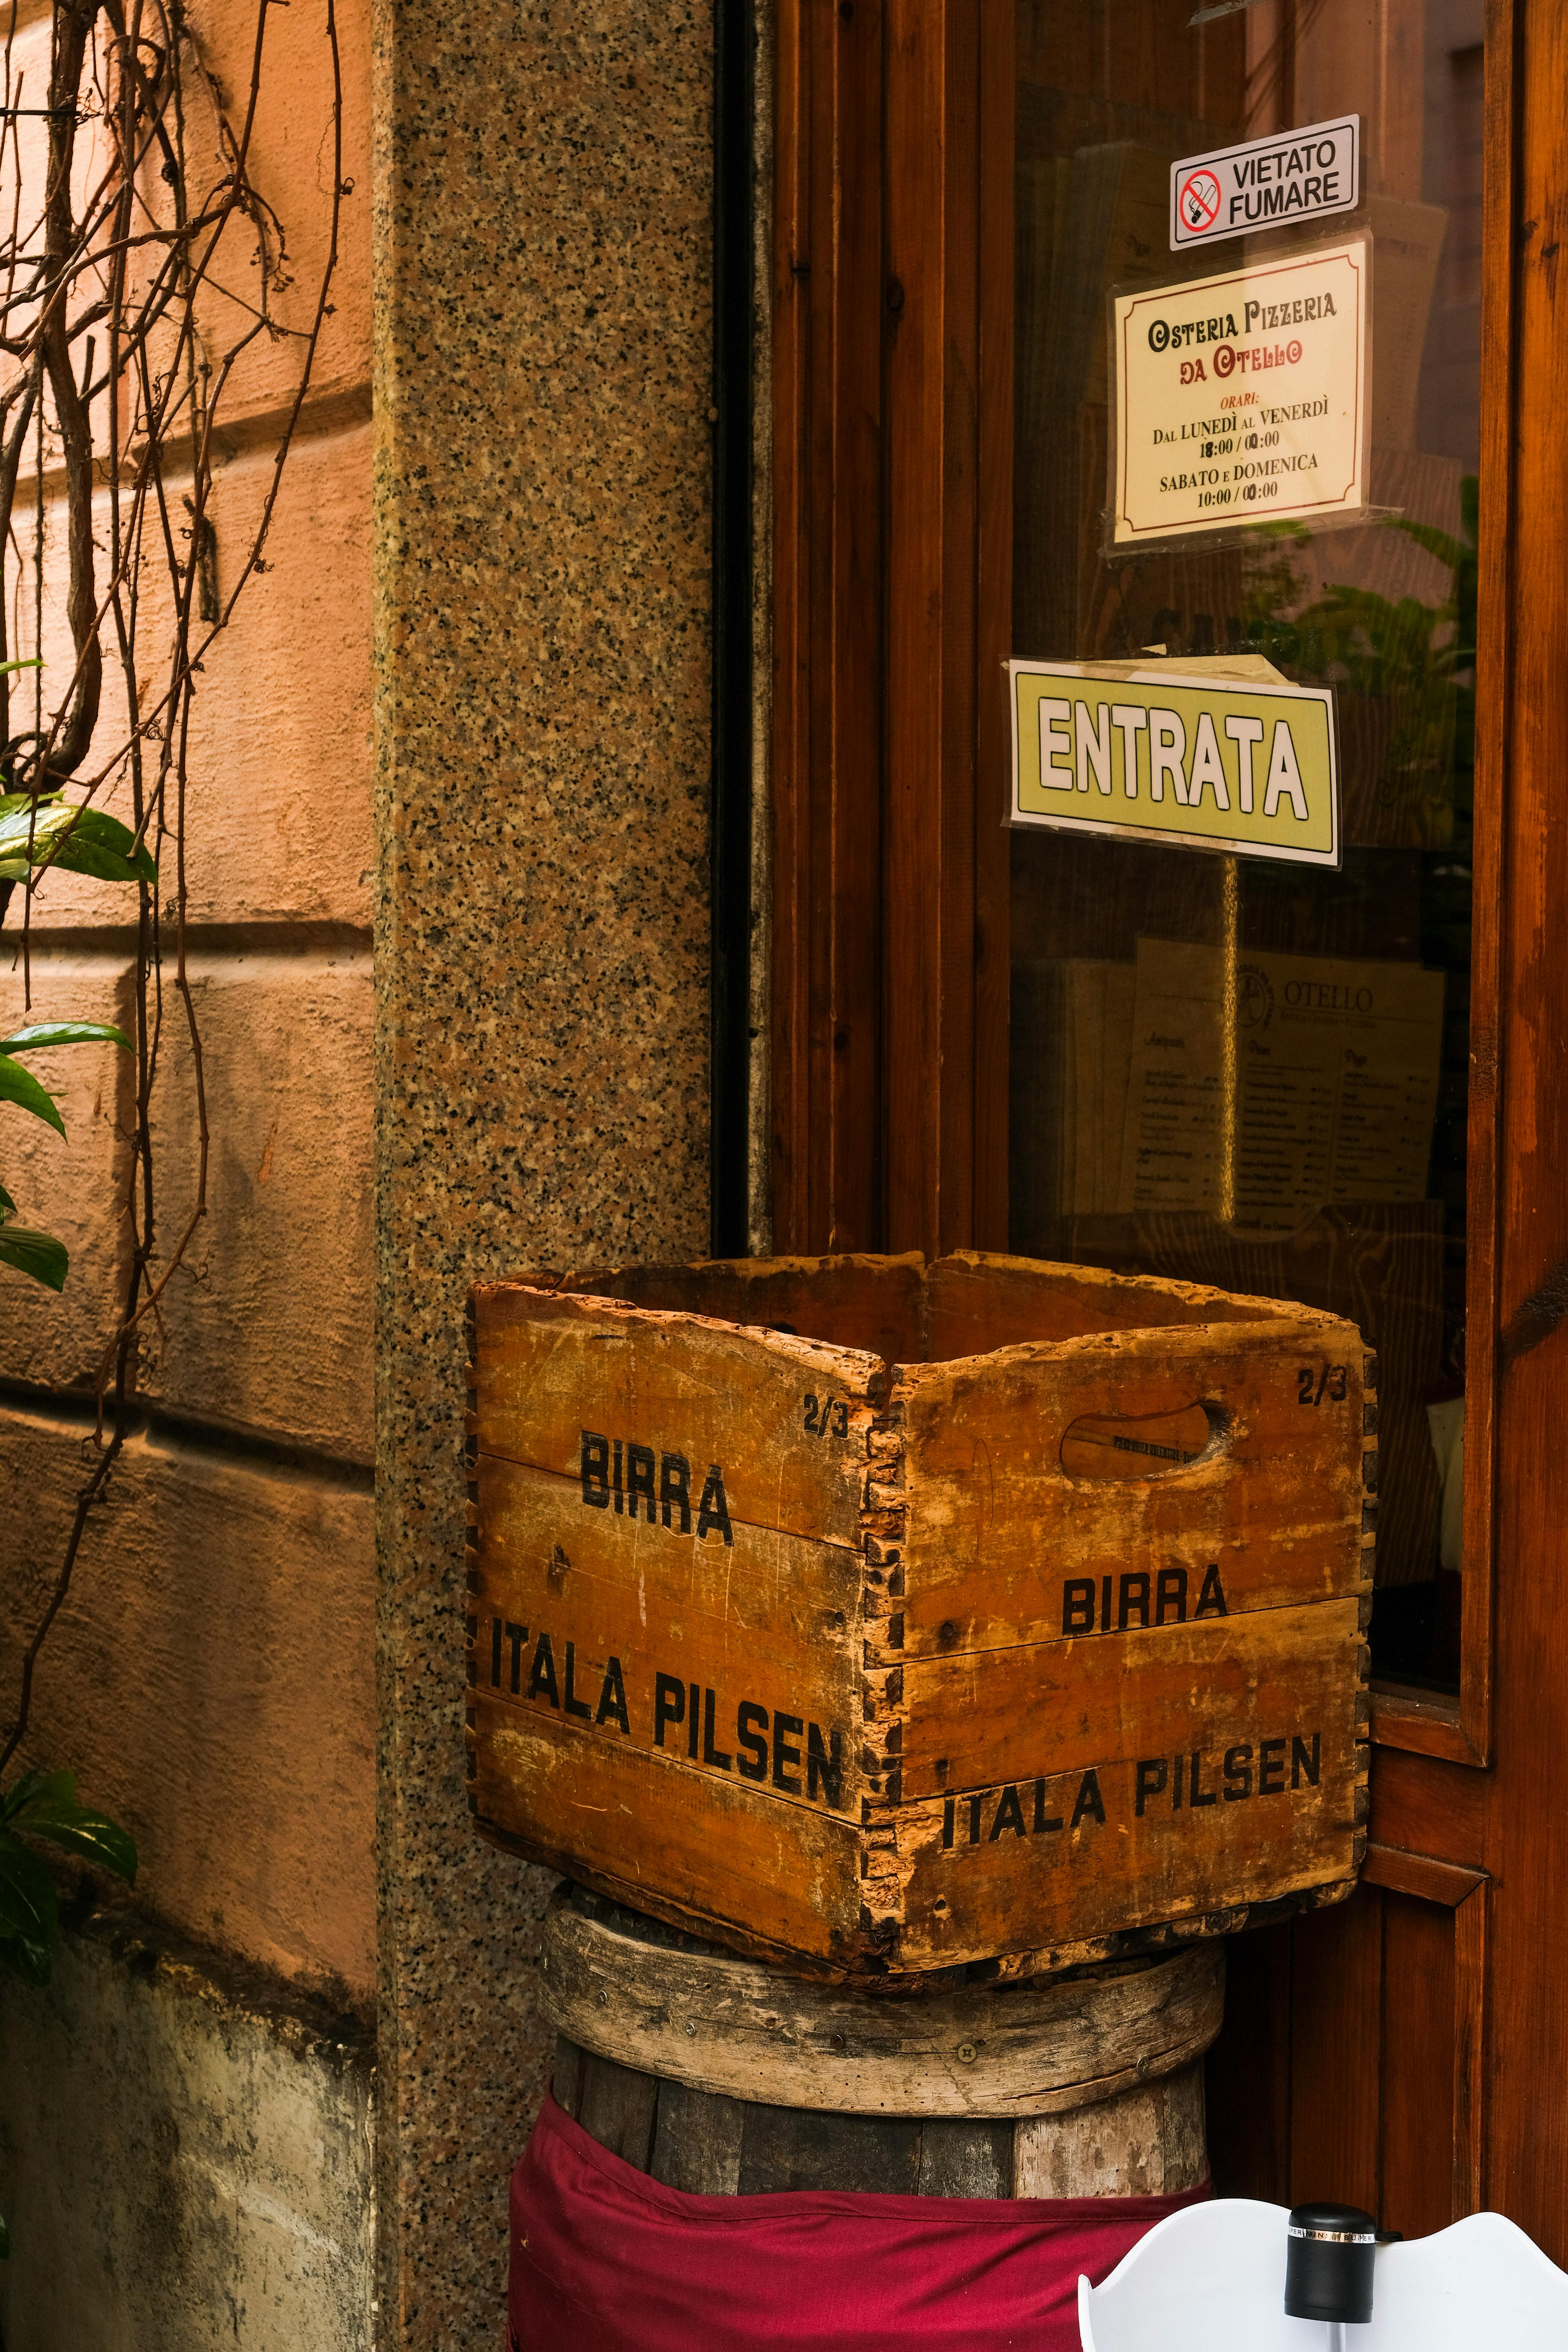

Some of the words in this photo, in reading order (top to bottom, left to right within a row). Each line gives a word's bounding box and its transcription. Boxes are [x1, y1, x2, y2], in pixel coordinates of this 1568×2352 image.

[1233, 140, 1335, 188] VIETATO
[1230, 171, 1339, 224] FUMARE
[1181, 411, 1237, 440] LUNEDÌ
[1260, 394, 1329, 426] VENERDÌ
[1221, 392, 1259, 410] ORARI:
[1160, 469, 1219, 493] SABATO
[1223, 471, 1230, 482] E
[1233, 453, 1318, 481] DOMENICA
[1198, 488, 1231, 507] 10:00
[1038, 697, 1309, 821] ENTRATA
[1285, 980, 1373, 1012] OTELLO
[1298, 1364, 1347, 1407] 2/3
[803, 1393, 849, 1440] 2/3
[580, 1430, 735, 1548] BIRRA
[1062, 1564, 1228, 1635] BIRRA
[490, 1616, 631, 1735] ITALA
[654, 1671, 844, 1810] PILSEN
[942, 1767, 1106, 1850] ITALA
[1134, 1733, 1320, 1817] PILSEN
